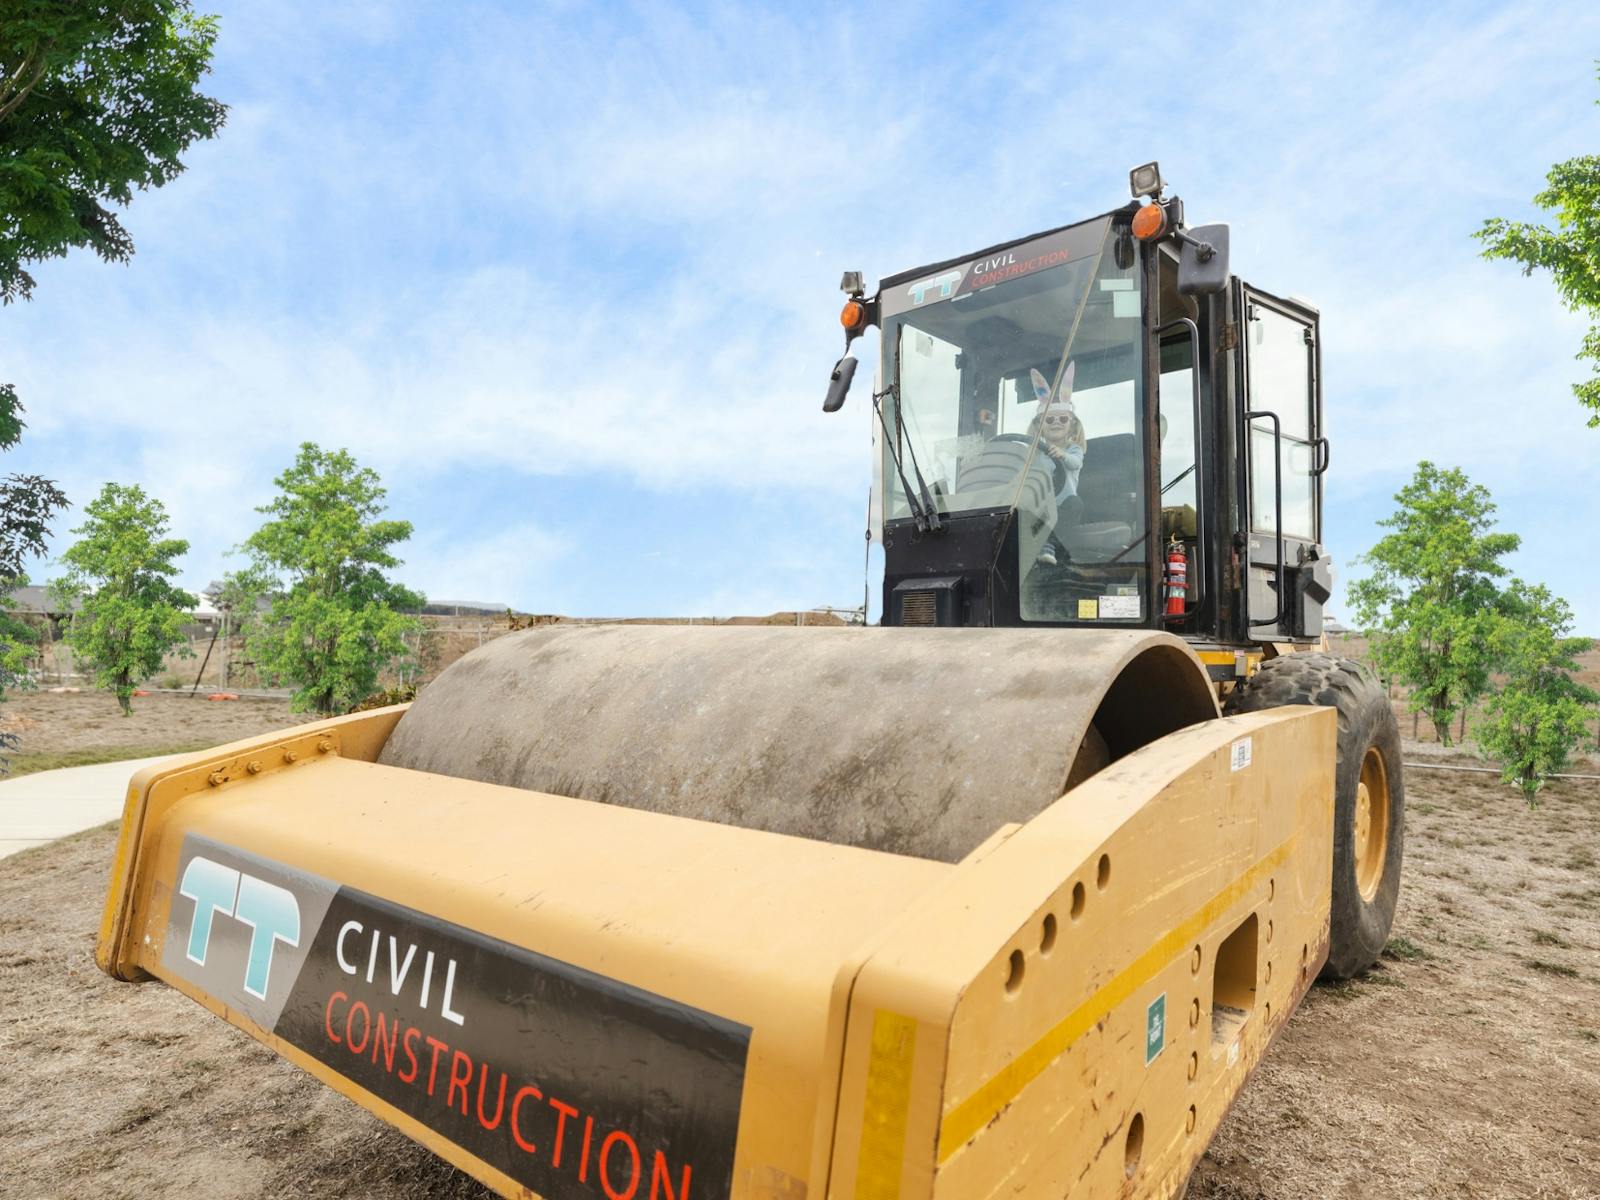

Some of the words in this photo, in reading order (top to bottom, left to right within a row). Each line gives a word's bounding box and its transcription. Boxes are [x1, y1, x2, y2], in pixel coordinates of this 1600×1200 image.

[971, 249, 1069, 288] CONSTRUCTION
[974, 253, 1017, 274] CIVIL
[179, 855, 301, 1002] TT
[336, 919, 466, 1027] CIVIL
[325, 990, 693, 1200] CONSTRUCTION
